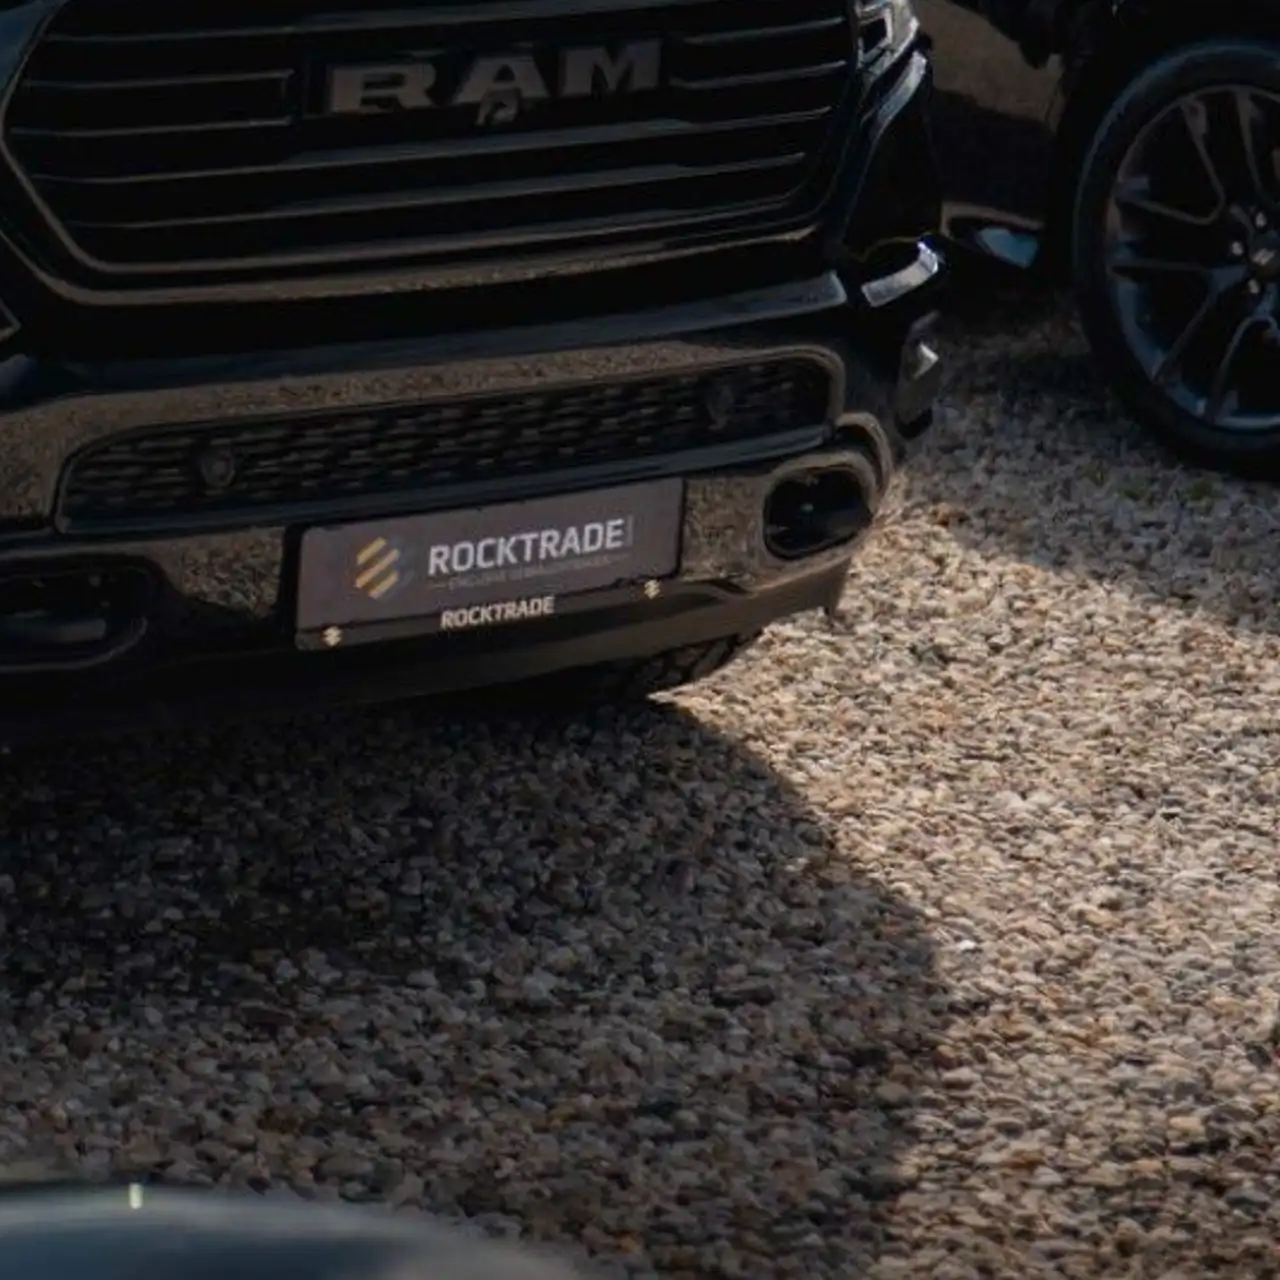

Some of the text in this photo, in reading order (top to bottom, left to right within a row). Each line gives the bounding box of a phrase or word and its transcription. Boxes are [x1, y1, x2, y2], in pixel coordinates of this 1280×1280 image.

[329, 39, 663, 115] RAM
[427, 519, 624, 577] ROCKTRADE
[440, 595, 556, 629] ROCKTRADE
